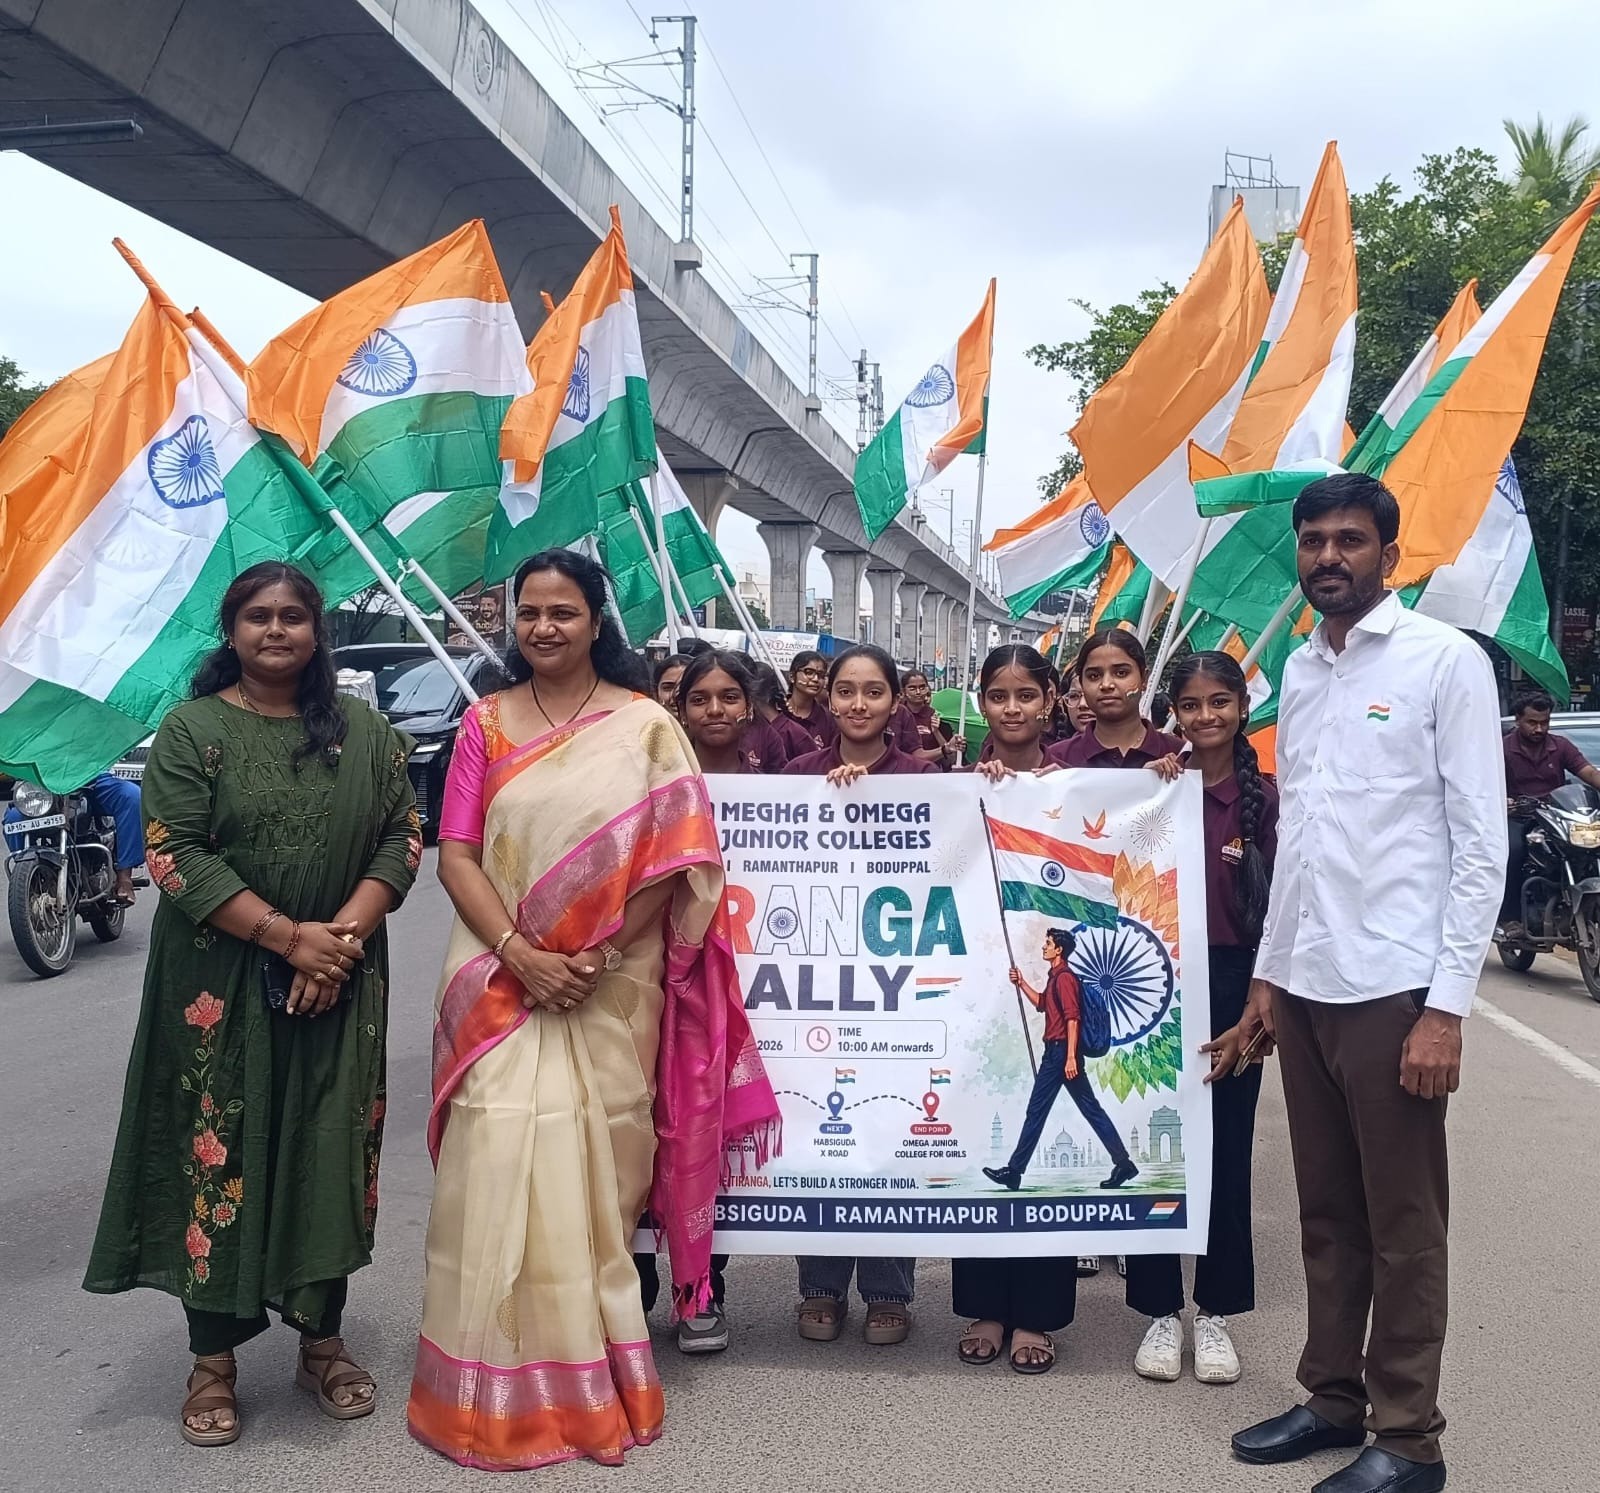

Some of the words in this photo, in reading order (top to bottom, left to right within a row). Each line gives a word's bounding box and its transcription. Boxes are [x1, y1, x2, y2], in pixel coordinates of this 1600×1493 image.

[721, 802, 809, 824] MEGHA
[818, 803, 835, 823] &
[844, 802, 931, 824] OMEGA
[31, 820, 41, 828] AU
[721, 829, 809, 852] JUNIOR
[817, 830, 932, 850] COLLEGES
[743, 860, 838, 873] RAMANTHAPUR
[866, 861, 931, 873] BODUPPAL
[725, 884, 968, 957] RANGA
[744, 963, 914, 1011] ALLY
[837, 1027, 862, 1037] TIME
[757, 1040, 783, 1051] 2026
[837, 1041, 867, 1052] 10:00
[870, 1042, 888, 1052] AM
[891, 1042, 934, 1053] onwards
[813, 1138, 857, 1146] HABSIGUDA
[902, 1139, 929, 1147] OMEGA
[931, 1139, 958, 1148] JUNIOR
[820, 1149, 826, 1158] X
[828, 1149, 849, 1158] ROAD
[895, 1150, 928, 1158] COLLEGE
[929, 1150, 944, 1158] FOR
[945, 1151, 967, 1159] GIRLS
[773, 1176, 798, 1188] LET'S
[800, 1177, 828, 1189] BUILD
[829, 1177, 837, 1189] A
[838, 1177, 888, 1190] STRONGER
[890, 1178, 919, 1190] INDIA.
[714, 1203, 807, 1223] BSIGUDA
[834, 1205, 998, 1225] RAMANTHAPUR
[1025, 1203, 1136, 1223] BODUPPAL
